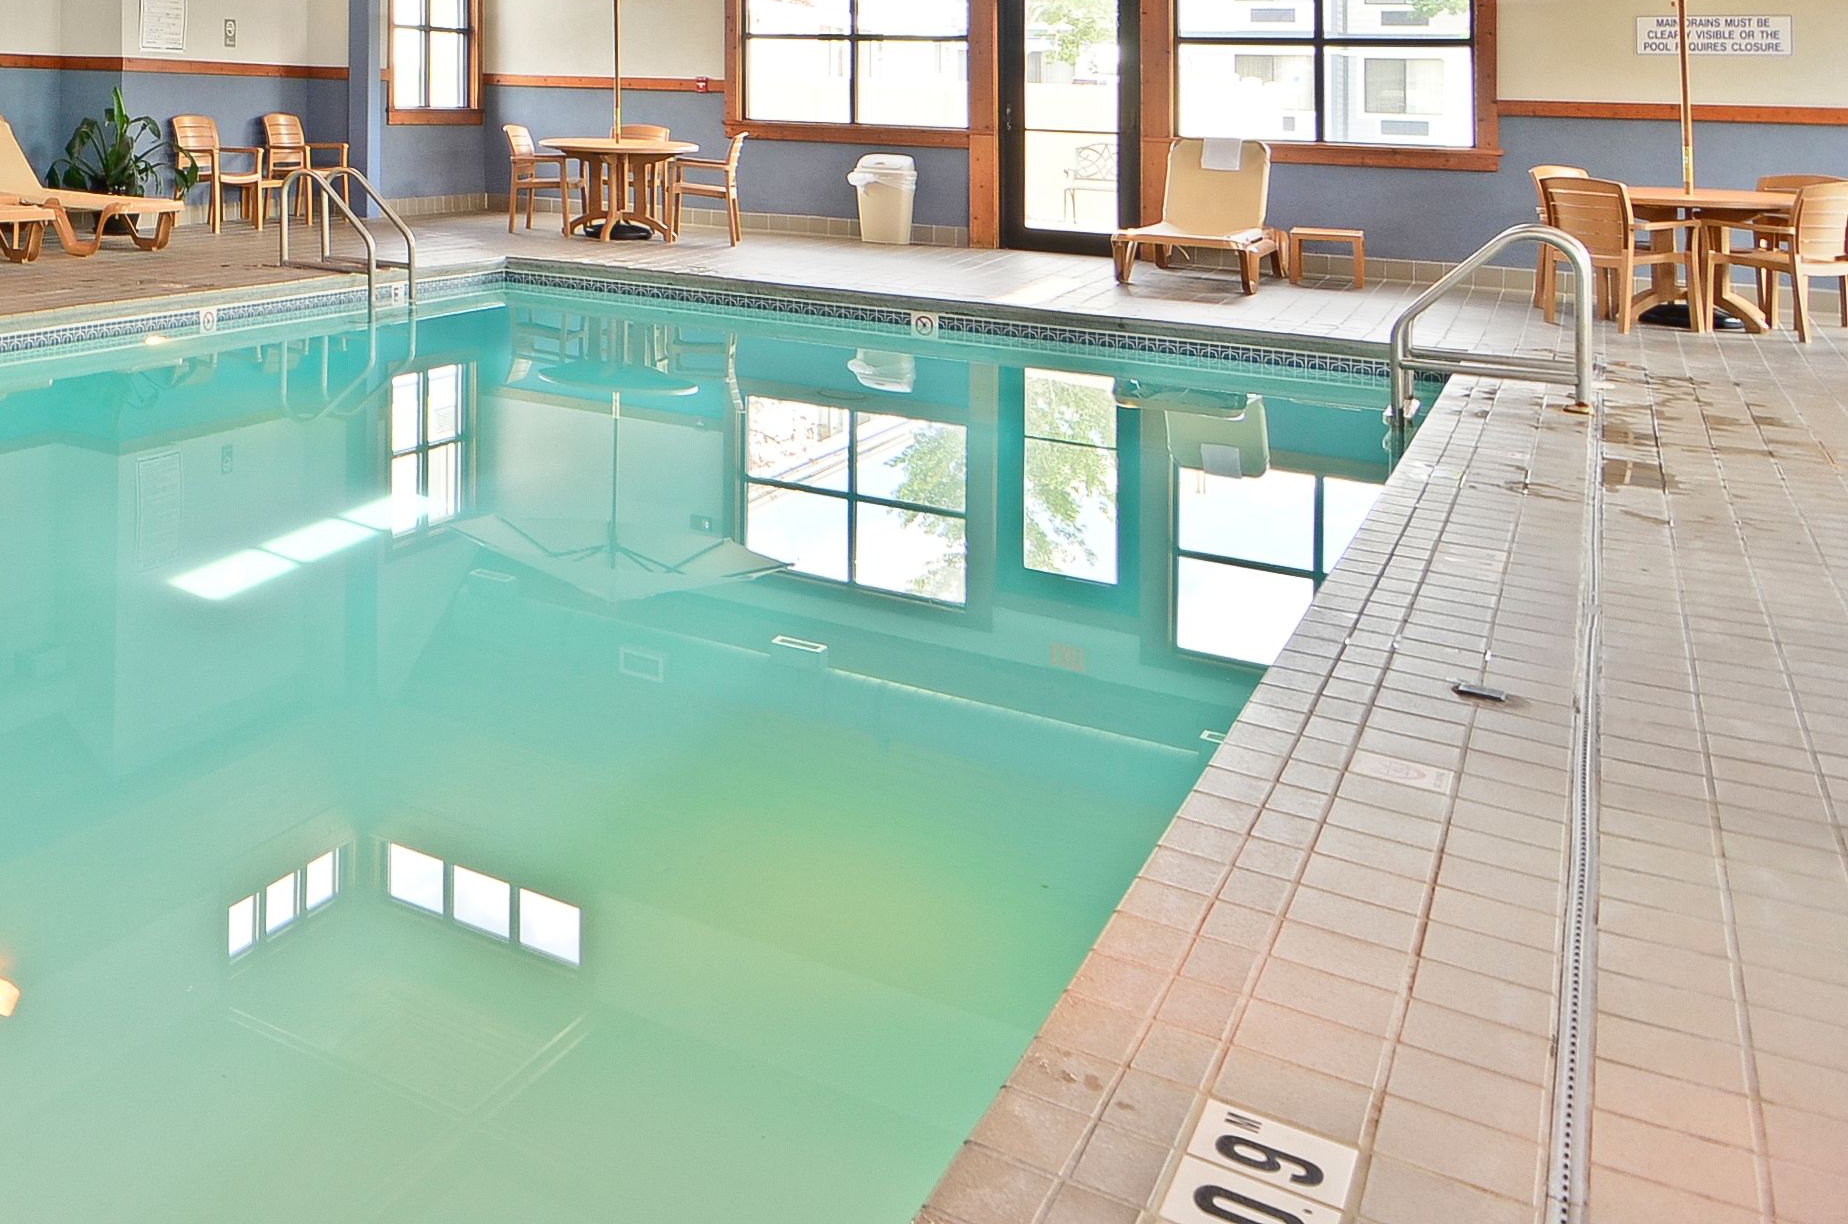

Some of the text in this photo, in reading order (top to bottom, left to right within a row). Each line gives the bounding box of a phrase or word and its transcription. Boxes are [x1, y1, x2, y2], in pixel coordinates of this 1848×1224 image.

[1725, 18, 1752, 27] MUST
[1757, 18, 1769, 27] BE
[1696, 30, 1734, 39] VISIBLE
[1740, 30, 1754, 39] OR
[1760, 30, 1780, 39] THE
[1644, 42, 1784, 52] POOL QUIRES CLOSURE.
